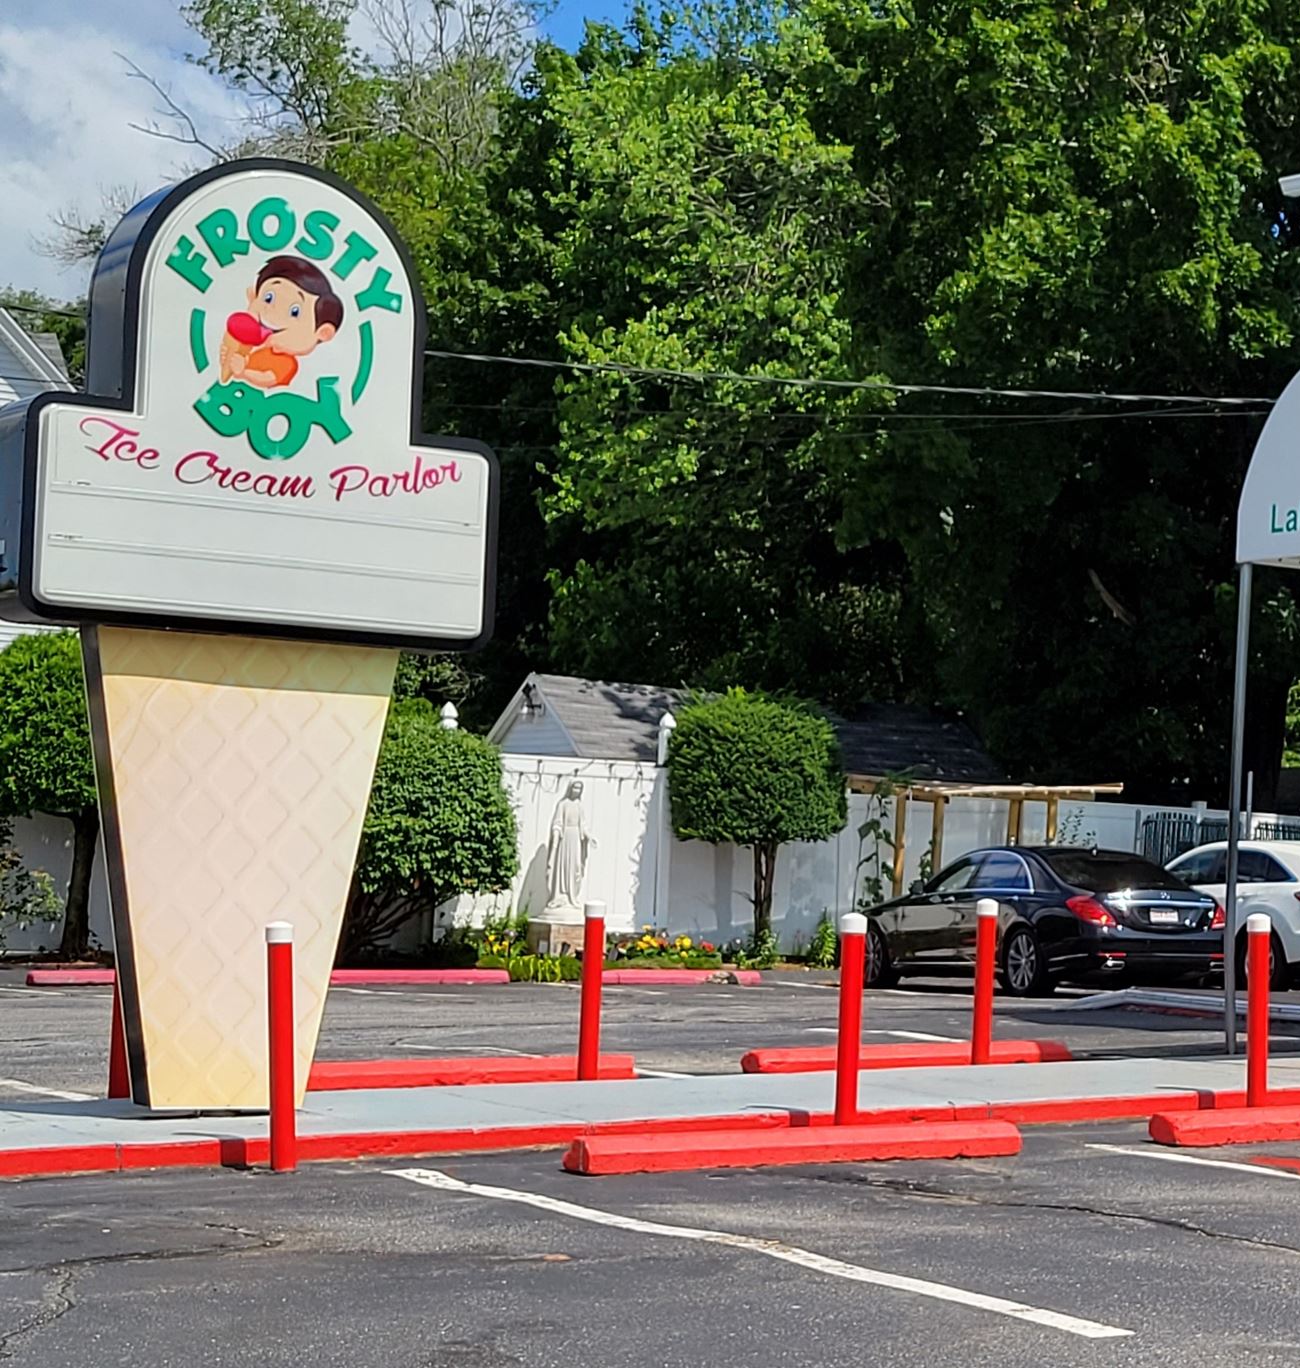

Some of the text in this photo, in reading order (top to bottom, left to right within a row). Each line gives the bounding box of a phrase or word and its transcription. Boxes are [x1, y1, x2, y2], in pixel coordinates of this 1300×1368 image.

[165, 196, 402, 314] FROSTY
[79, 416, 462, 501] Ice Cream Parlor
[193, 376, 353, 460] BOY
